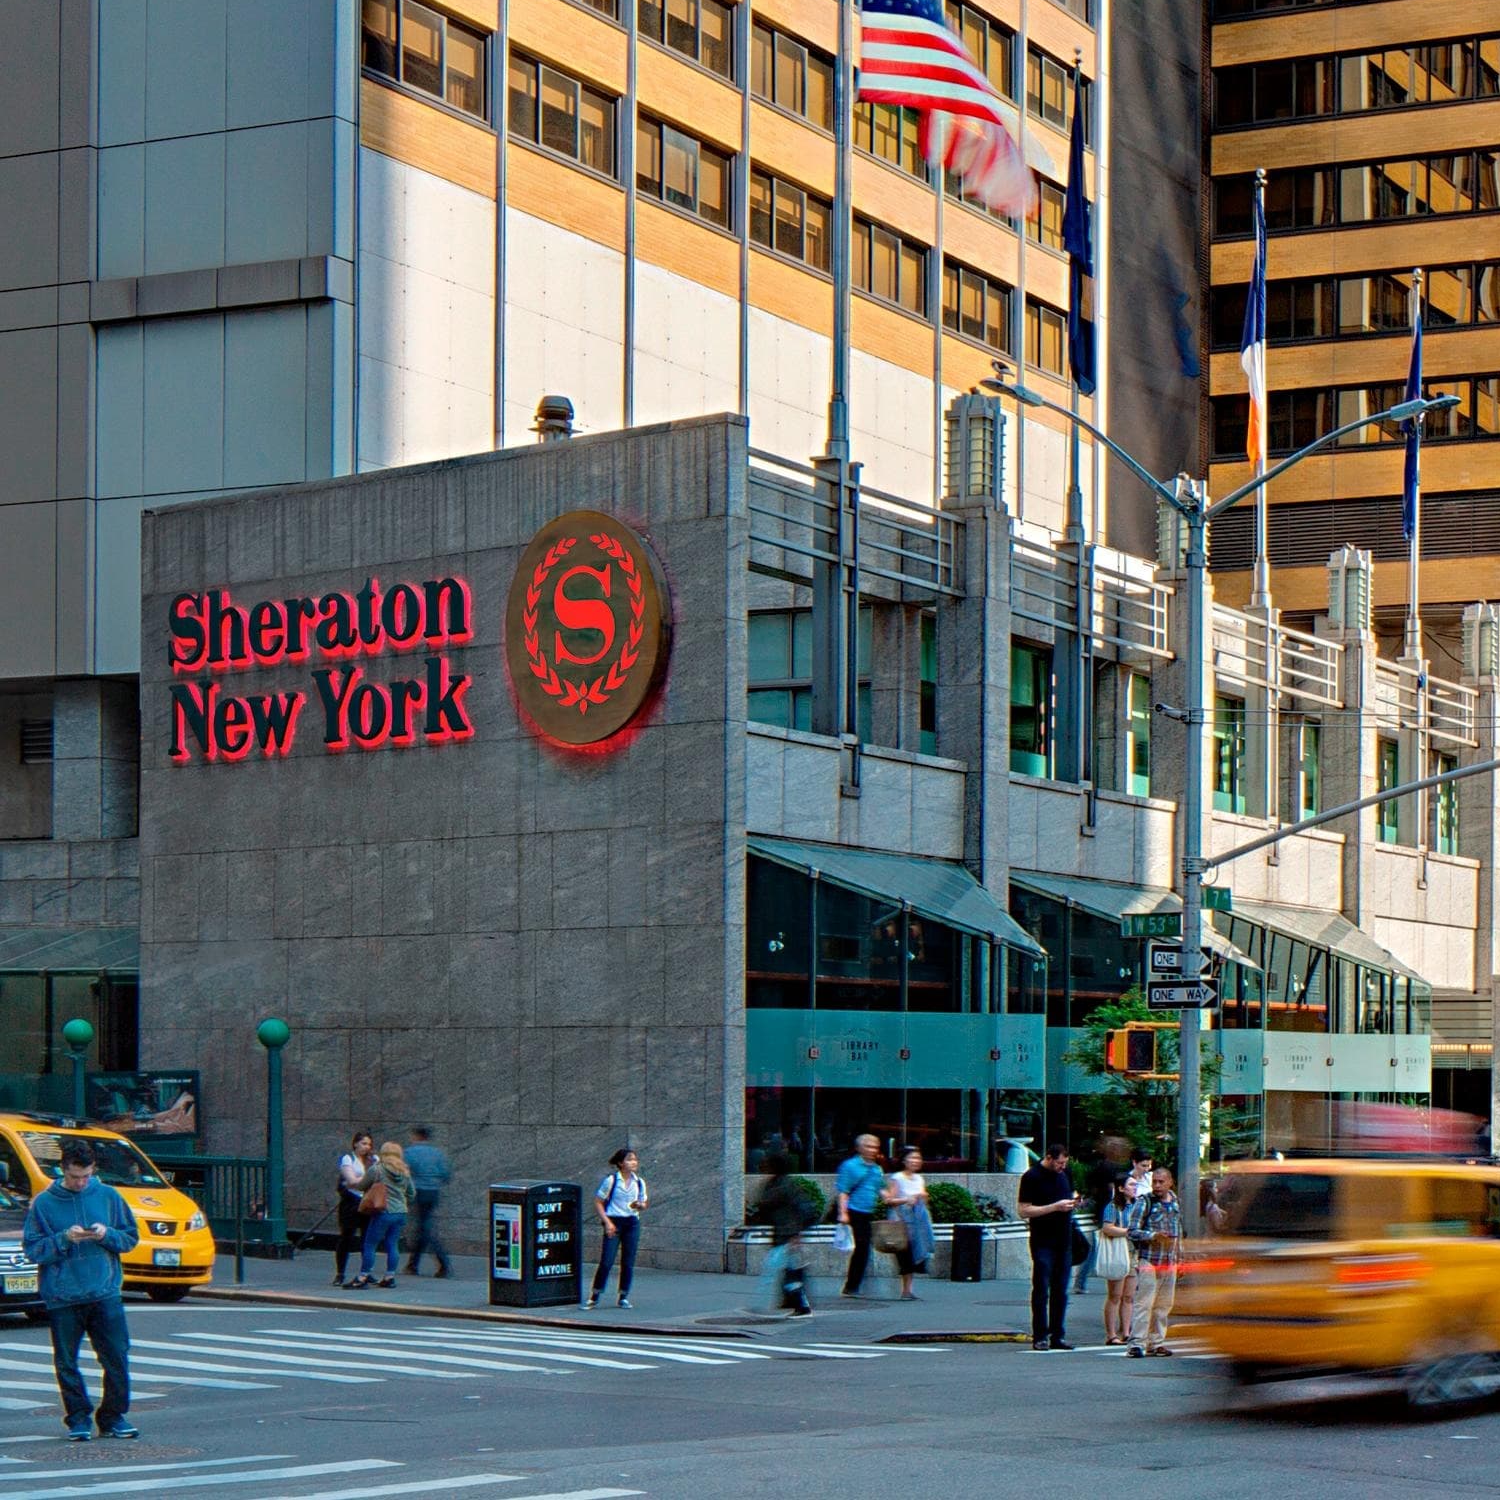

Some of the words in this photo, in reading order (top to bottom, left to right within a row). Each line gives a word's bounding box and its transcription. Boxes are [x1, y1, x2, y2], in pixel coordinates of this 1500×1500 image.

[553, 564, 616, 665] S
[168, 576, 471, 670] Sheraton
[168, 680, 303, 760] New
[312, 656, 472, 748] York
[1212, 890, 1220, 907] 7
[1134, 916, 1144, 933] W
[1148, 916, 1166, 933] 53
[1155, 953, 1176, 965] ONE
[1153, 989, 1175, 1001] ONE
[1186, 988, 1210, 1001] WAY
[840, 1041, 879, 1051] LIBRARY
[851, 1051, 868, 1061] BAR
[537, 1202, 563, 1213] DON'T
[537, 1219, 550, 1229] BE
[537, 1232, 570, 1243] AFRAID
[537, 1248, 550, 1259] OF
[537, 1263, 572, 1275] ANYONE
